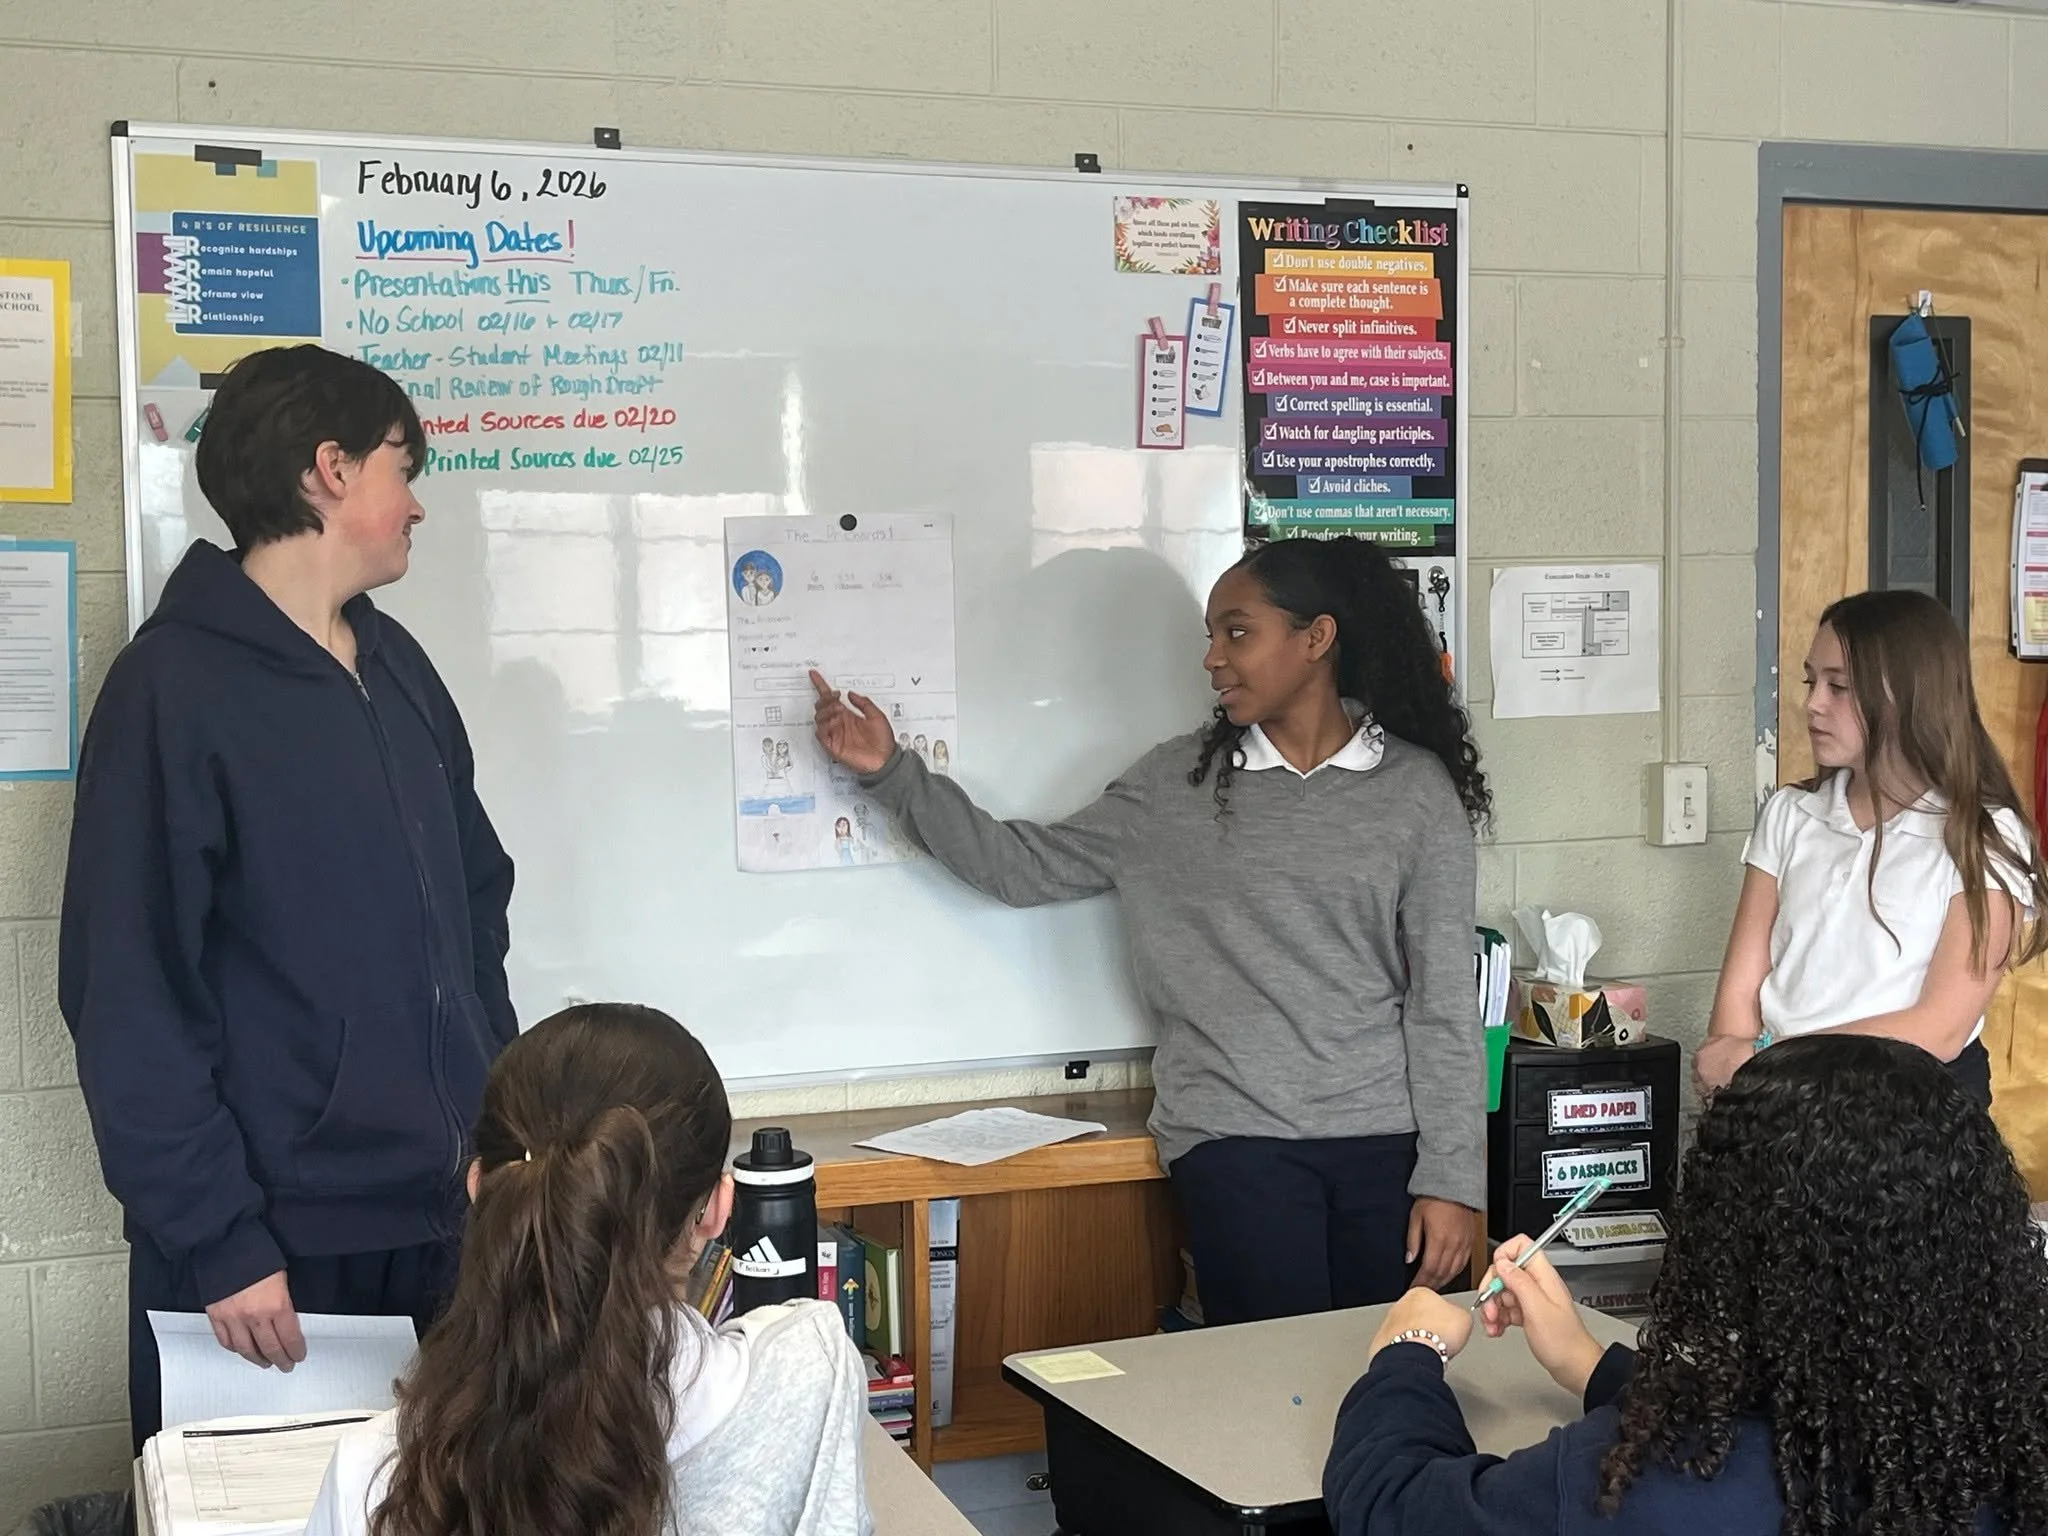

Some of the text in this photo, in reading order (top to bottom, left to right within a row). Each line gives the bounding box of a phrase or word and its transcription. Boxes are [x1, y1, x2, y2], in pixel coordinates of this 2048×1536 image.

[358, 160, 482, 209] February
[536, 168, 607, 199] 2026
[194, 221, 212, 230] R'S
[218, 222, 233, 231] OF
[238, 223, 307, 234] RESILIENCE
[1247, 216, 1449, 249] Writing Checklist
[185, 236, 298, 257] Recognize hardships
[357, 219, 480, 269] Upcoming
[186, 259, 274, 279] Remain hopeful
[1286, 254, 1428, 274] Don't use double negatives.
[186, 282, 264, 301] Reframe view
[354, 269, 500, 299] Presentations
[505, 268, 552, 297] this
[1289, 279, 1428, 295] Make sure each sentence is
[187, 304, 264, 324] Relationships
[1289, 295, 1393, 313] a complete thought.
[359, 308, 389, 335] No
[396, 305, 463, 333] School
[477, 311, 536, 335] 02/16
[568, 310, 623, 334] 02/17
[1298, 320, 1417, 338] Never split infinitives.
[543, 344, 628, 374] Meetings
[638, 343, 684, 371] 02/11
[1269, 344, 1447, 364] Verbs have to agree with their subjects.
[450, 374, 514, 399] Review
[519, 373, 543, 397] of
[550, 373, 602, 401] Rough
[606, 375, 664, 396] Draft
[1267, 372, 1450, 391] Between you and me, case is important.
[1290, 397, 1433, 415] Correct spelling is essential.
[422, 405, 677, 435] nted Sources due 02/20
[1279, 425, 1435, 445] Watch for dangling participles.
[510, 446, 577, 470] Sources
[583, 446, 622, 470] due
[628, 446, 684, 473] 02/25
[1276, 453, 1435, 472] Use your apostrophes correctly.
[1322, 479, 1391, 494] Avoid cliches.
[1267, 504, 1450, 522] Don't use commas that aren't necessary.
[1380, 527, 1421, 546] writing.
[1564, 1101, 1637, 1119] LINED PAPER
[1557, 1160, 1638, 1180] 6 PASSBACKS
[1596, 1222, 1660, 1238] PASSBACKS
